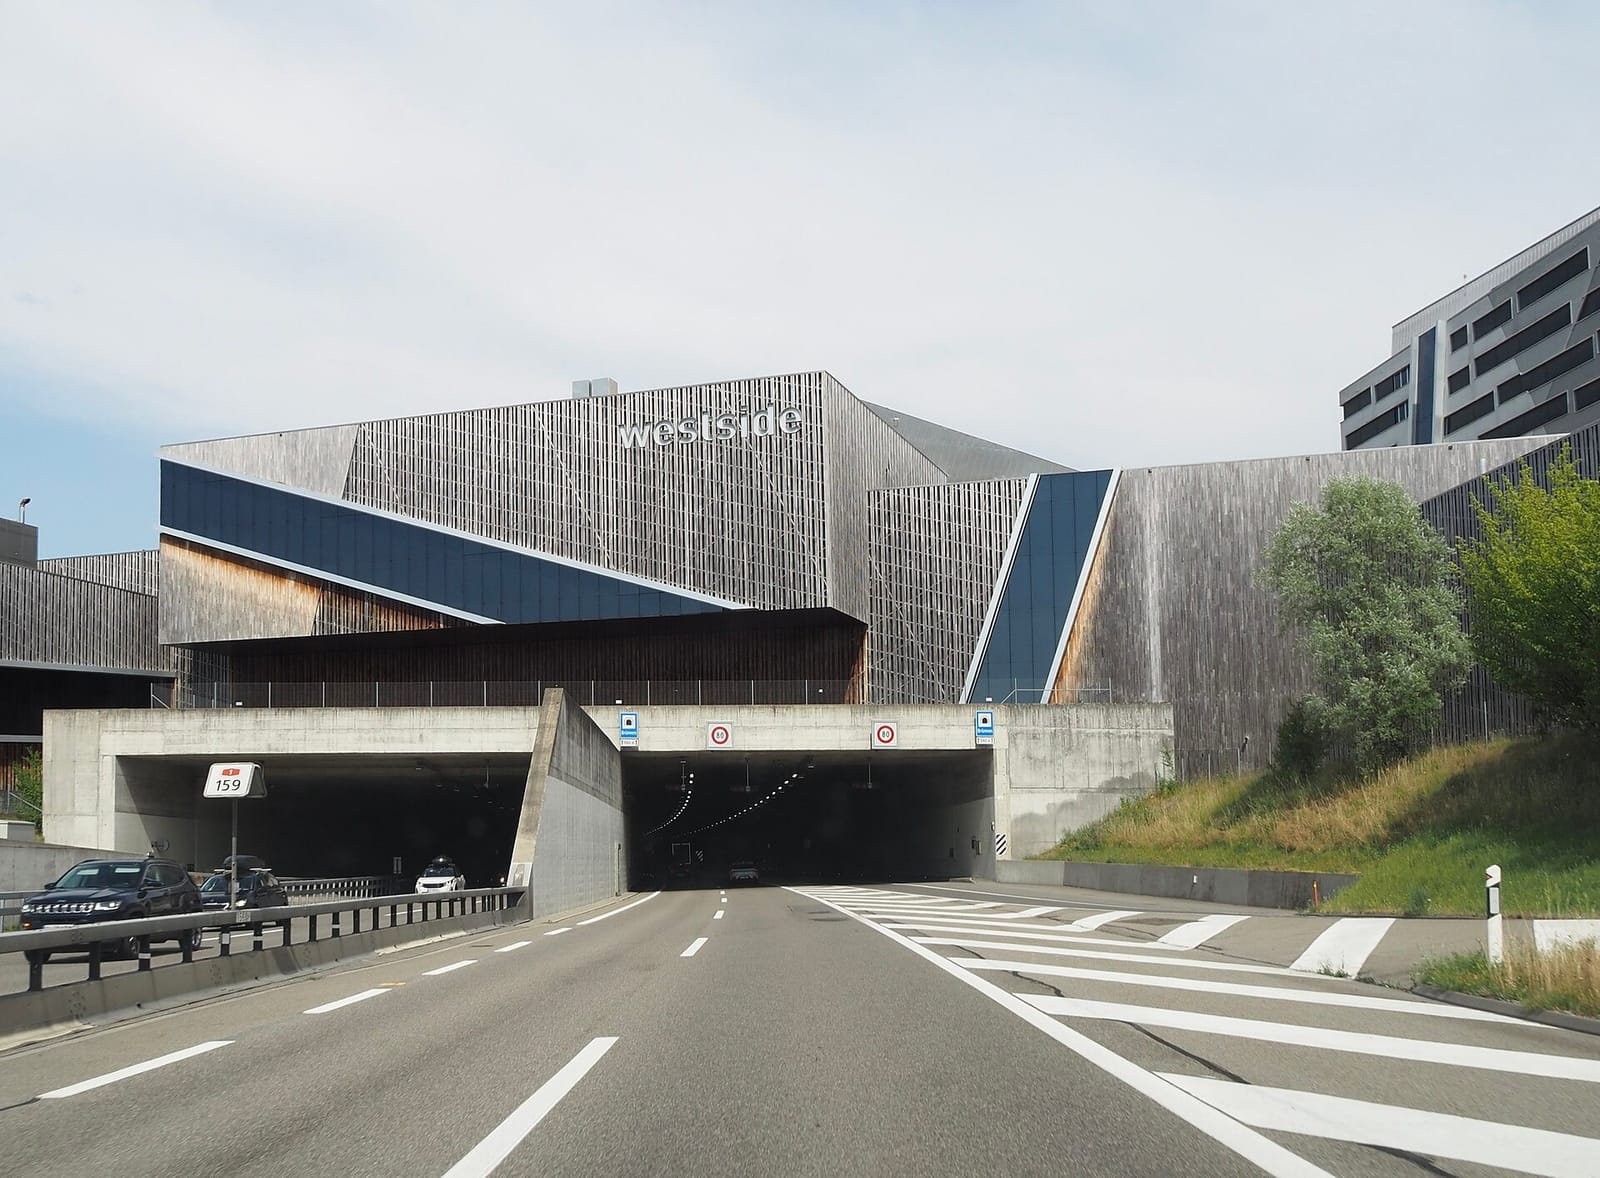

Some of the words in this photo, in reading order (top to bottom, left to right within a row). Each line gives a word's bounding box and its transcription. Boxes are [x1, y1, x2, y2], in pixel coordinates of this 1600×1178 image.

[618, 402, 801, 449] westside
[716, 731, 725, 739] 80
[882, 730, 890, 738] 80
[216, 779, 241, 792] 159
